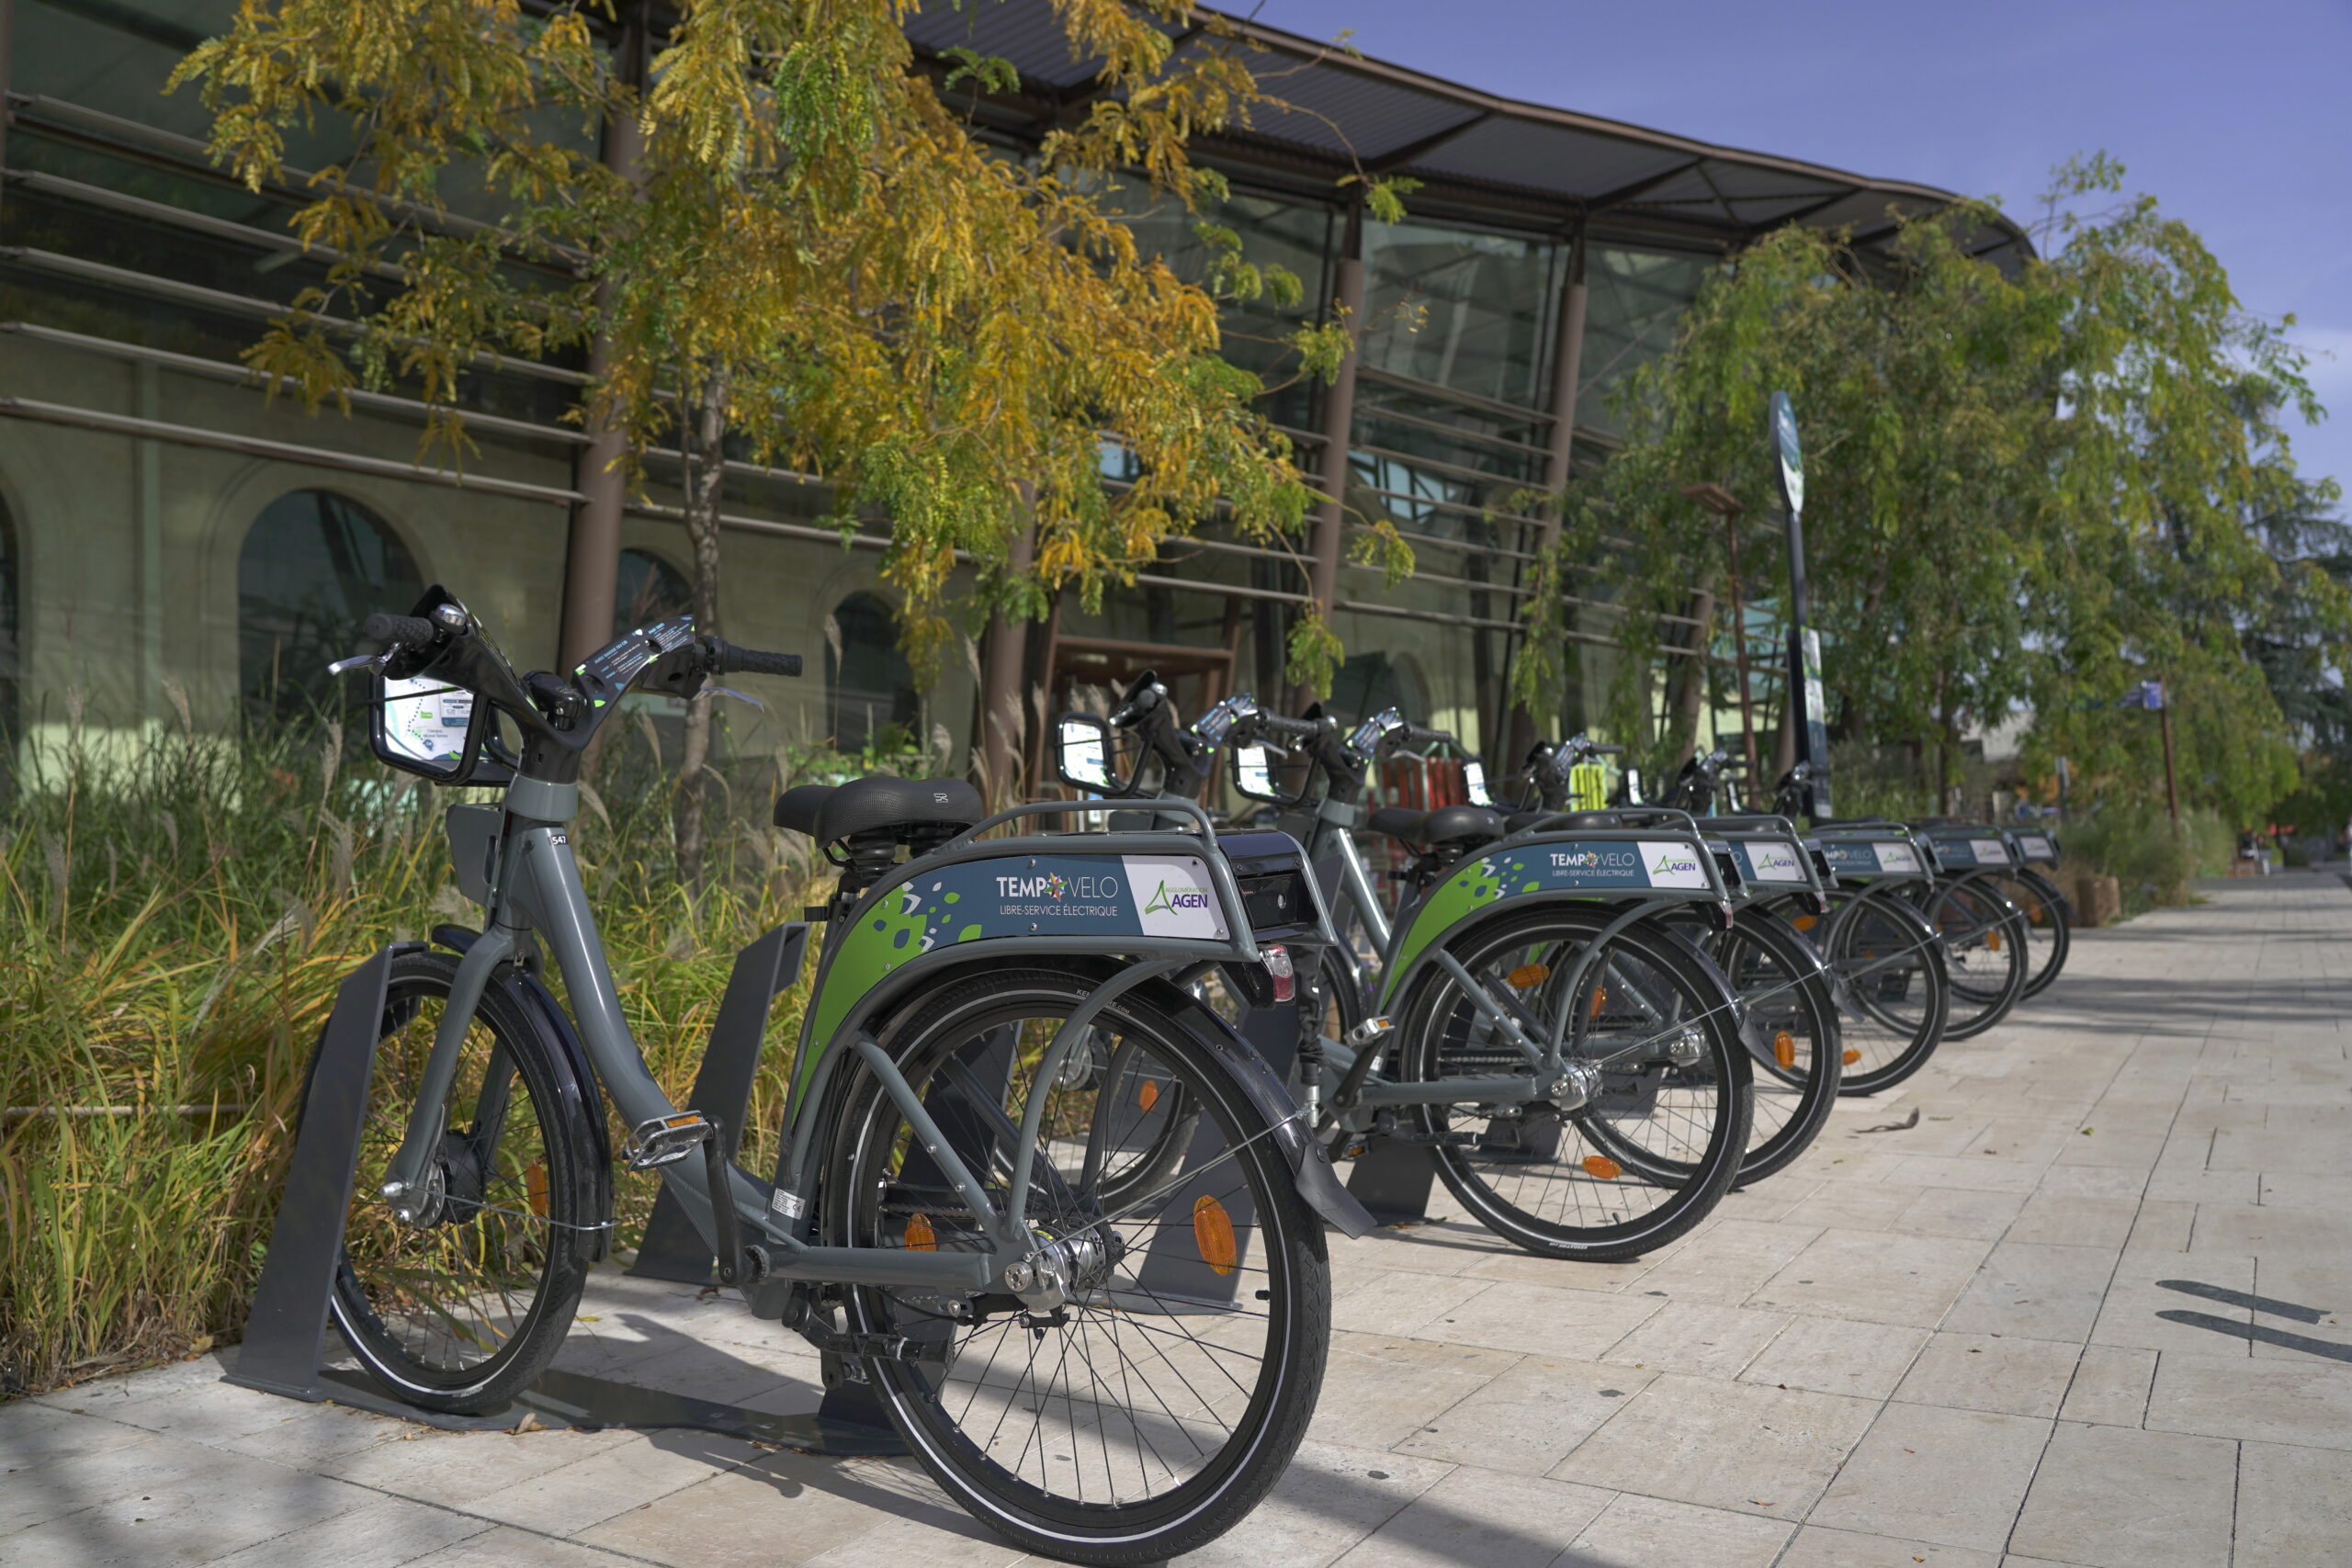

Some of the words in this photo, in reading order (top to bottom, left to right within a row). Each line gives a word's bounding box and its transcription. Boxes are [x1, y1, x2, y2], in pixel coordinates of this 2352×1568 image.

[552, 835, 566, 845] 547
[1600, 852, 1634, 866] VELO
[1671, 863, 1696, 871] AGEN
[1068, 876, 1118, 898] VELO
[1171, 894, 1208, 908] AGEN
[1000, 905, 1061, 916] LIBRE-SERVICE
[1063, 903, 1117, 917] ÉLECTRIQUE
